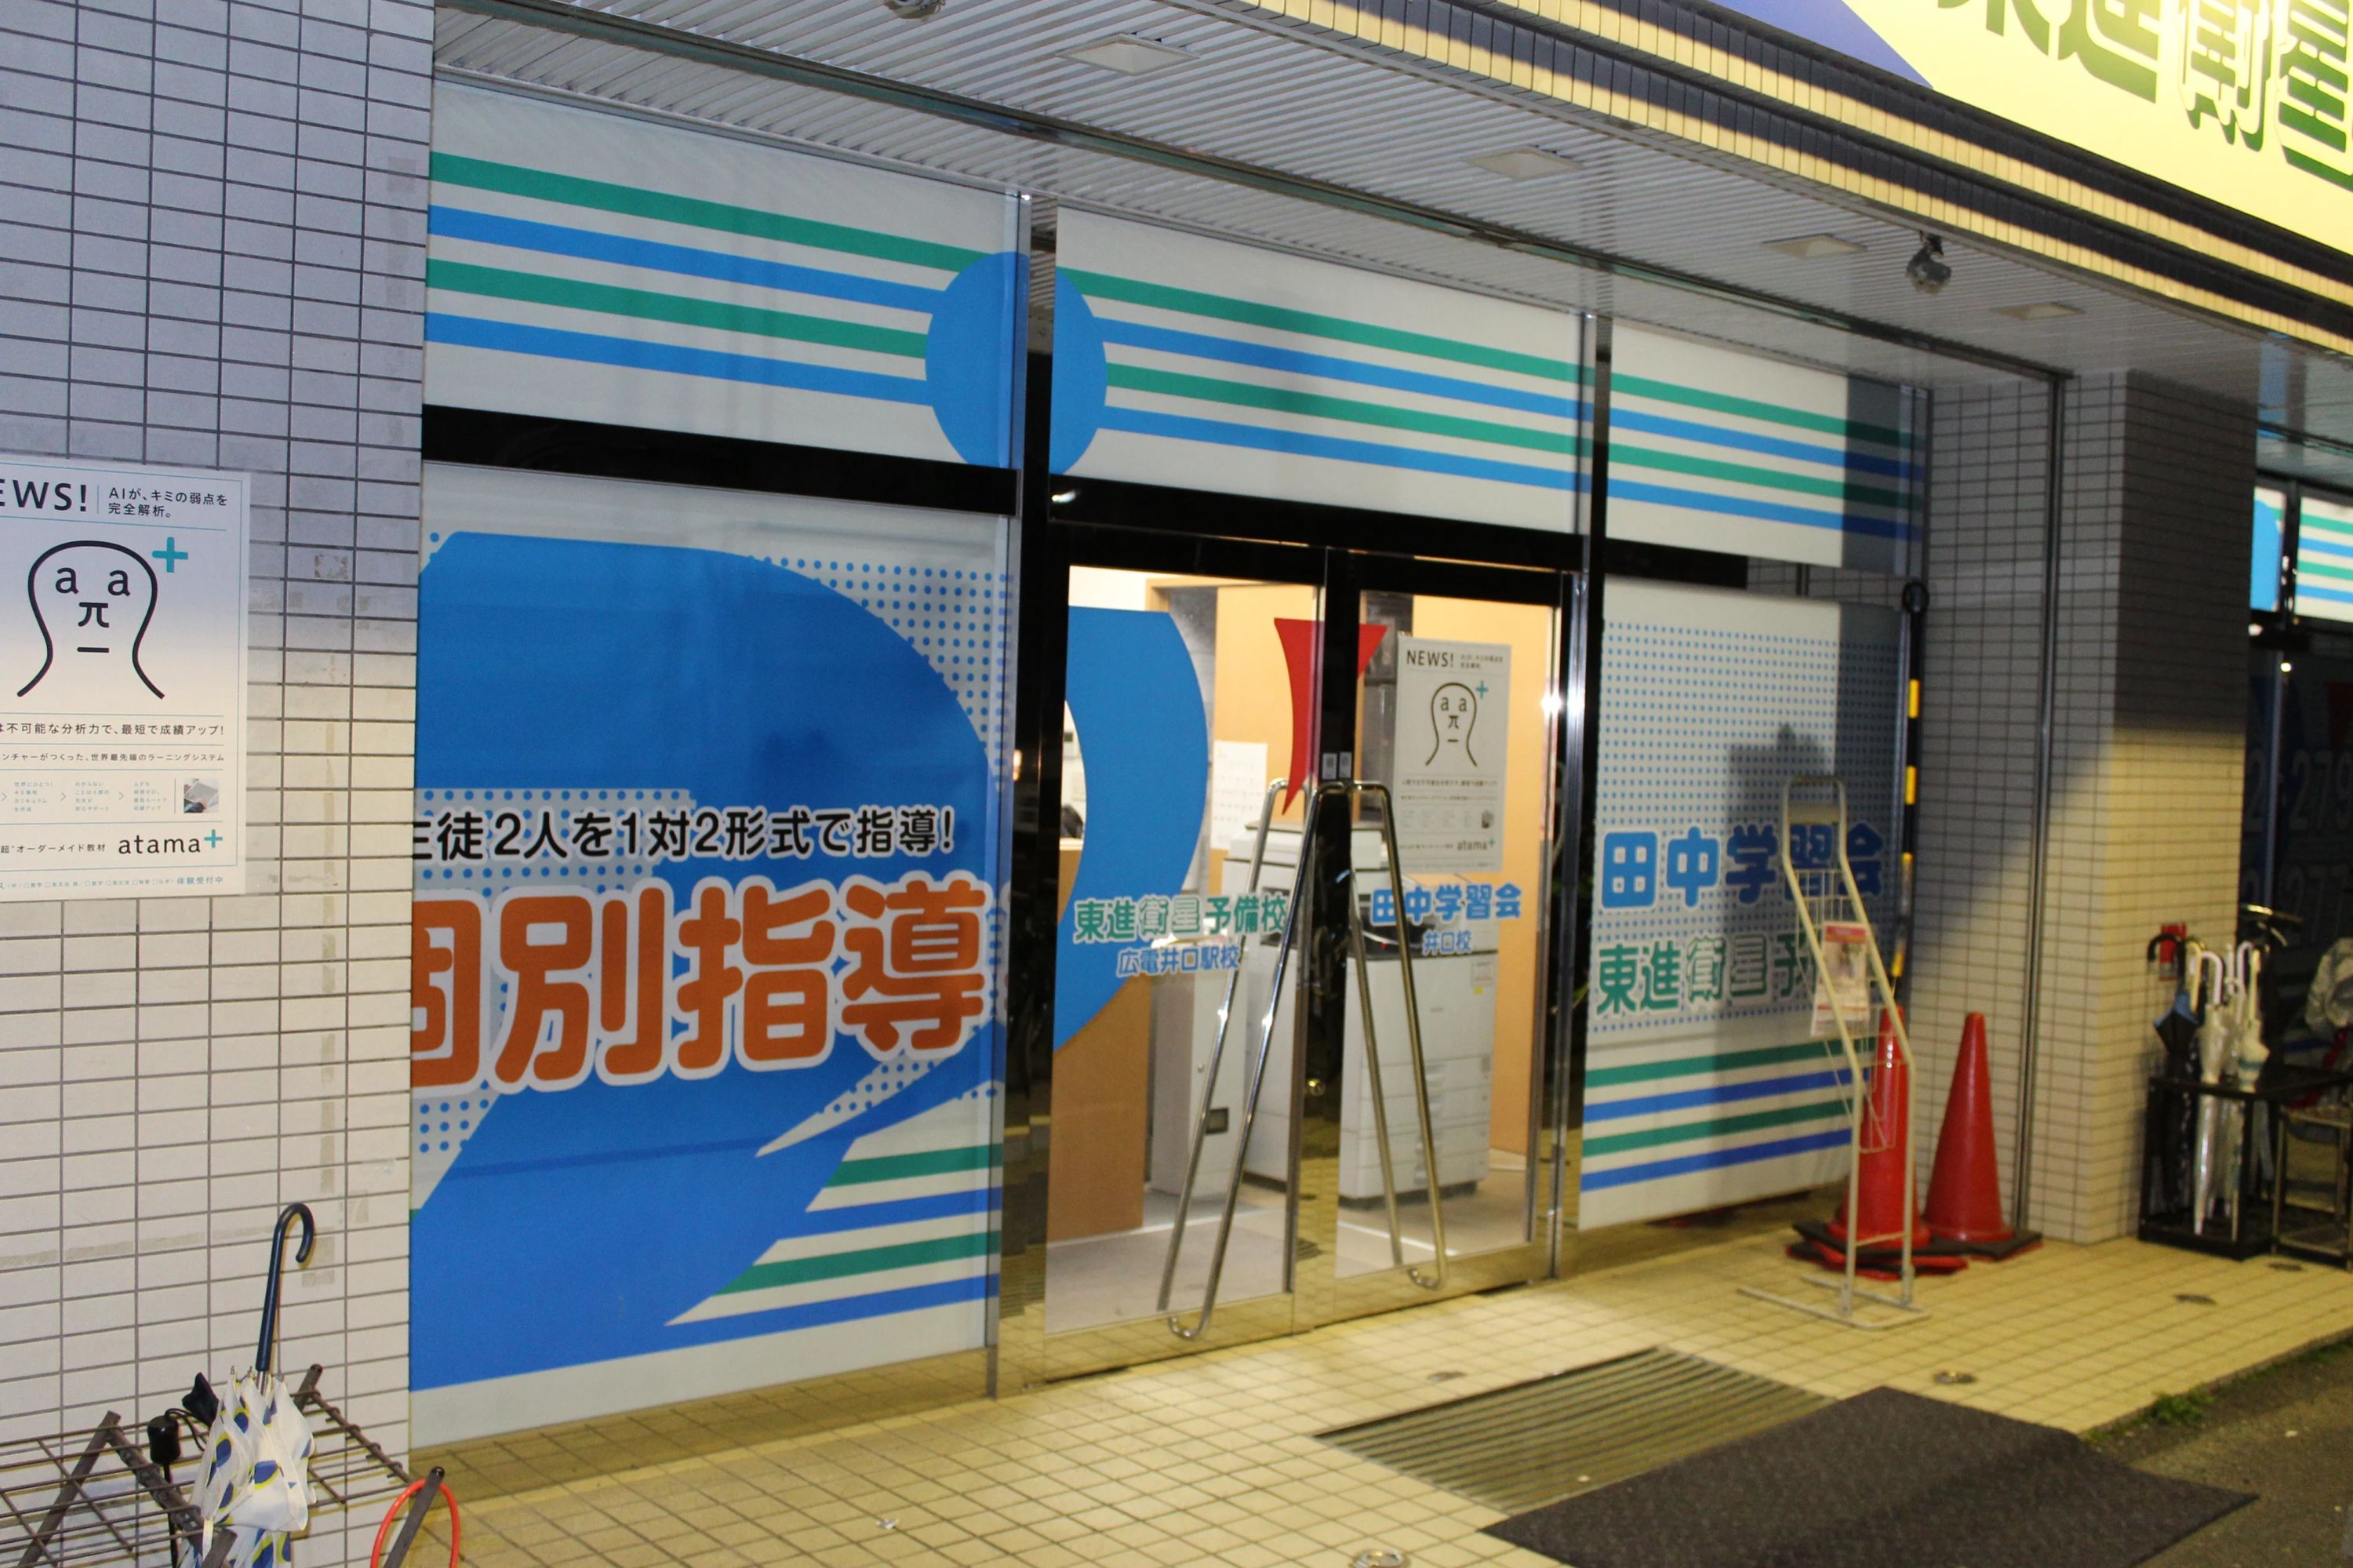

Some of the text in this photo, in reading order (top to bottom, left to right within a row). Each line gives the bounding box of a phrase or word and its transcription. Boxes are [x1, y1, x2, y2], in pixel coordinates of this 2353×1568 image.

[108, 486, 227, 507] AIが、キミの弱点を
[108, 503, 172, 518] 完全解析。
[1406, 650, 1454, 668] NEWS!
[1601, 823, 1883, 908] 田中学習会
[1372, 882, 1522, 923] 田中学習会
[1423, 930, 1471, 955] 井口校
[1596, 933, 1875, 1015] 東進衛星予
